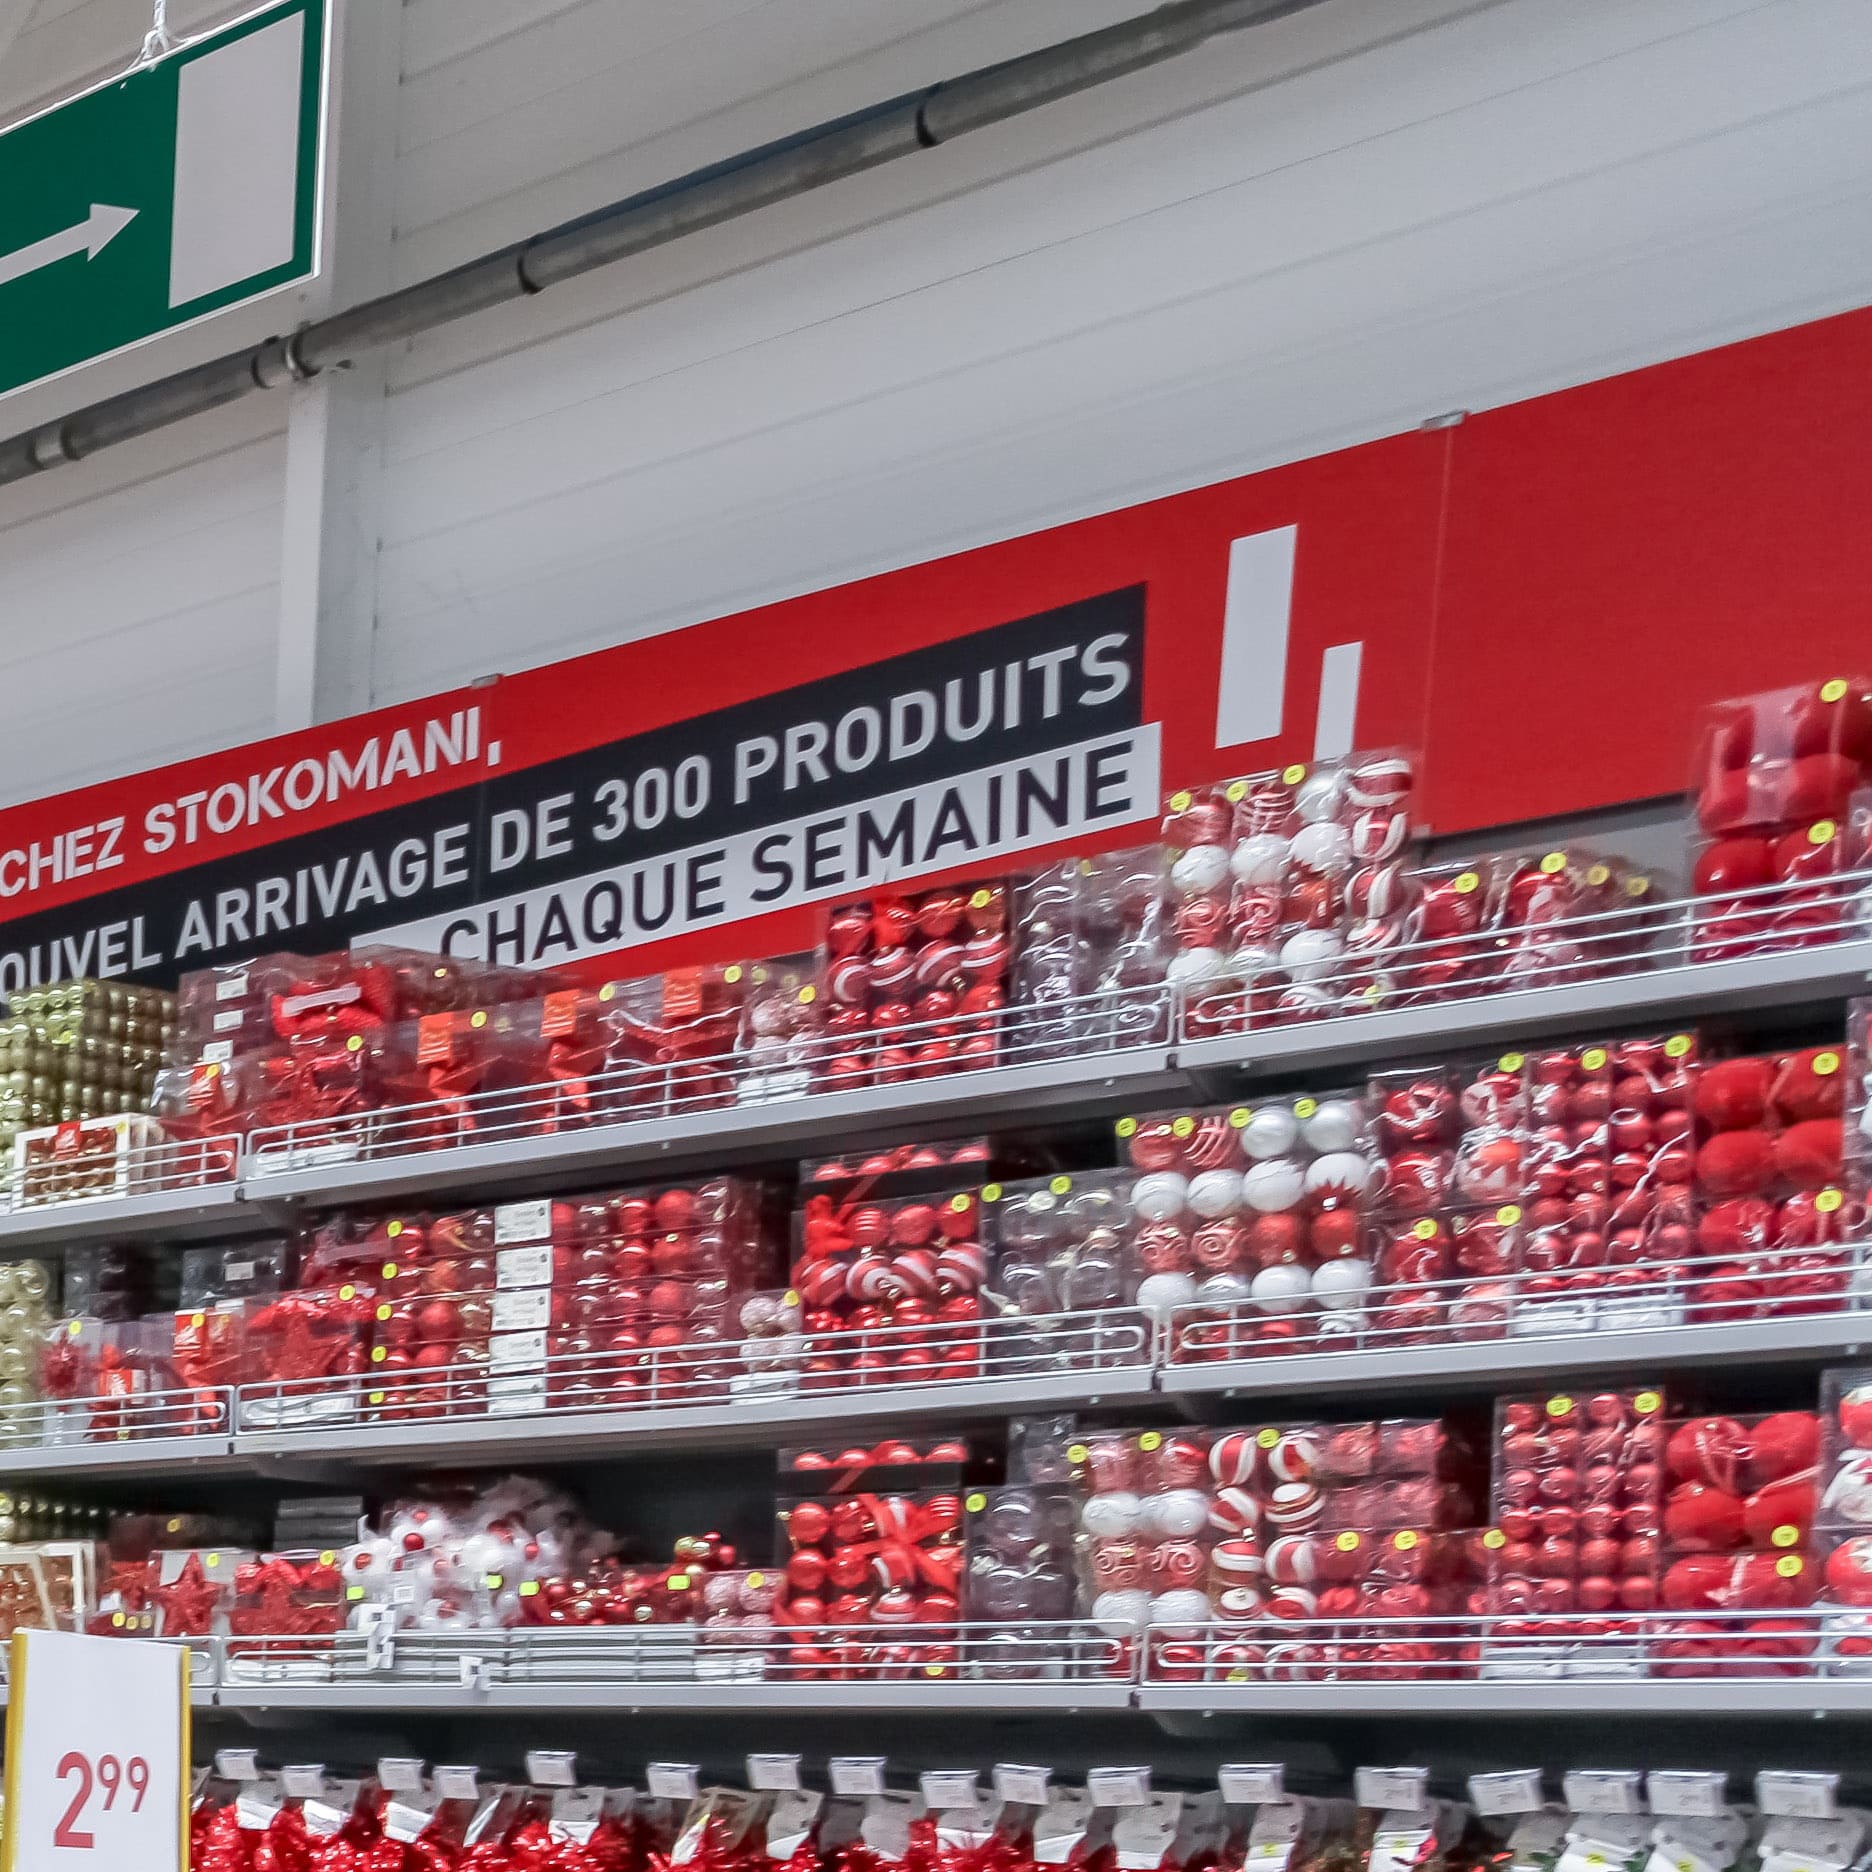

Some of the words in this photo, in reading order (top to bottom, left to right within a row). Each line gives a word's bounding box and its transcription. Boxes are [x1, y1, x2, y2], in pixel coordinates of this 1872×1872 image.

[142, 706, 502, 854] STOKOMANI,
[174, 824, 470, 958] ARRIVAGE
[490, 794, 574, 874] DE
[592, 754, 711, 842] 300
[734, 632, 1132, 804] PRODUITS
[442, 849, 726, 966] CHAQUE
[749, 738, 1135, 902] SEMAINE
